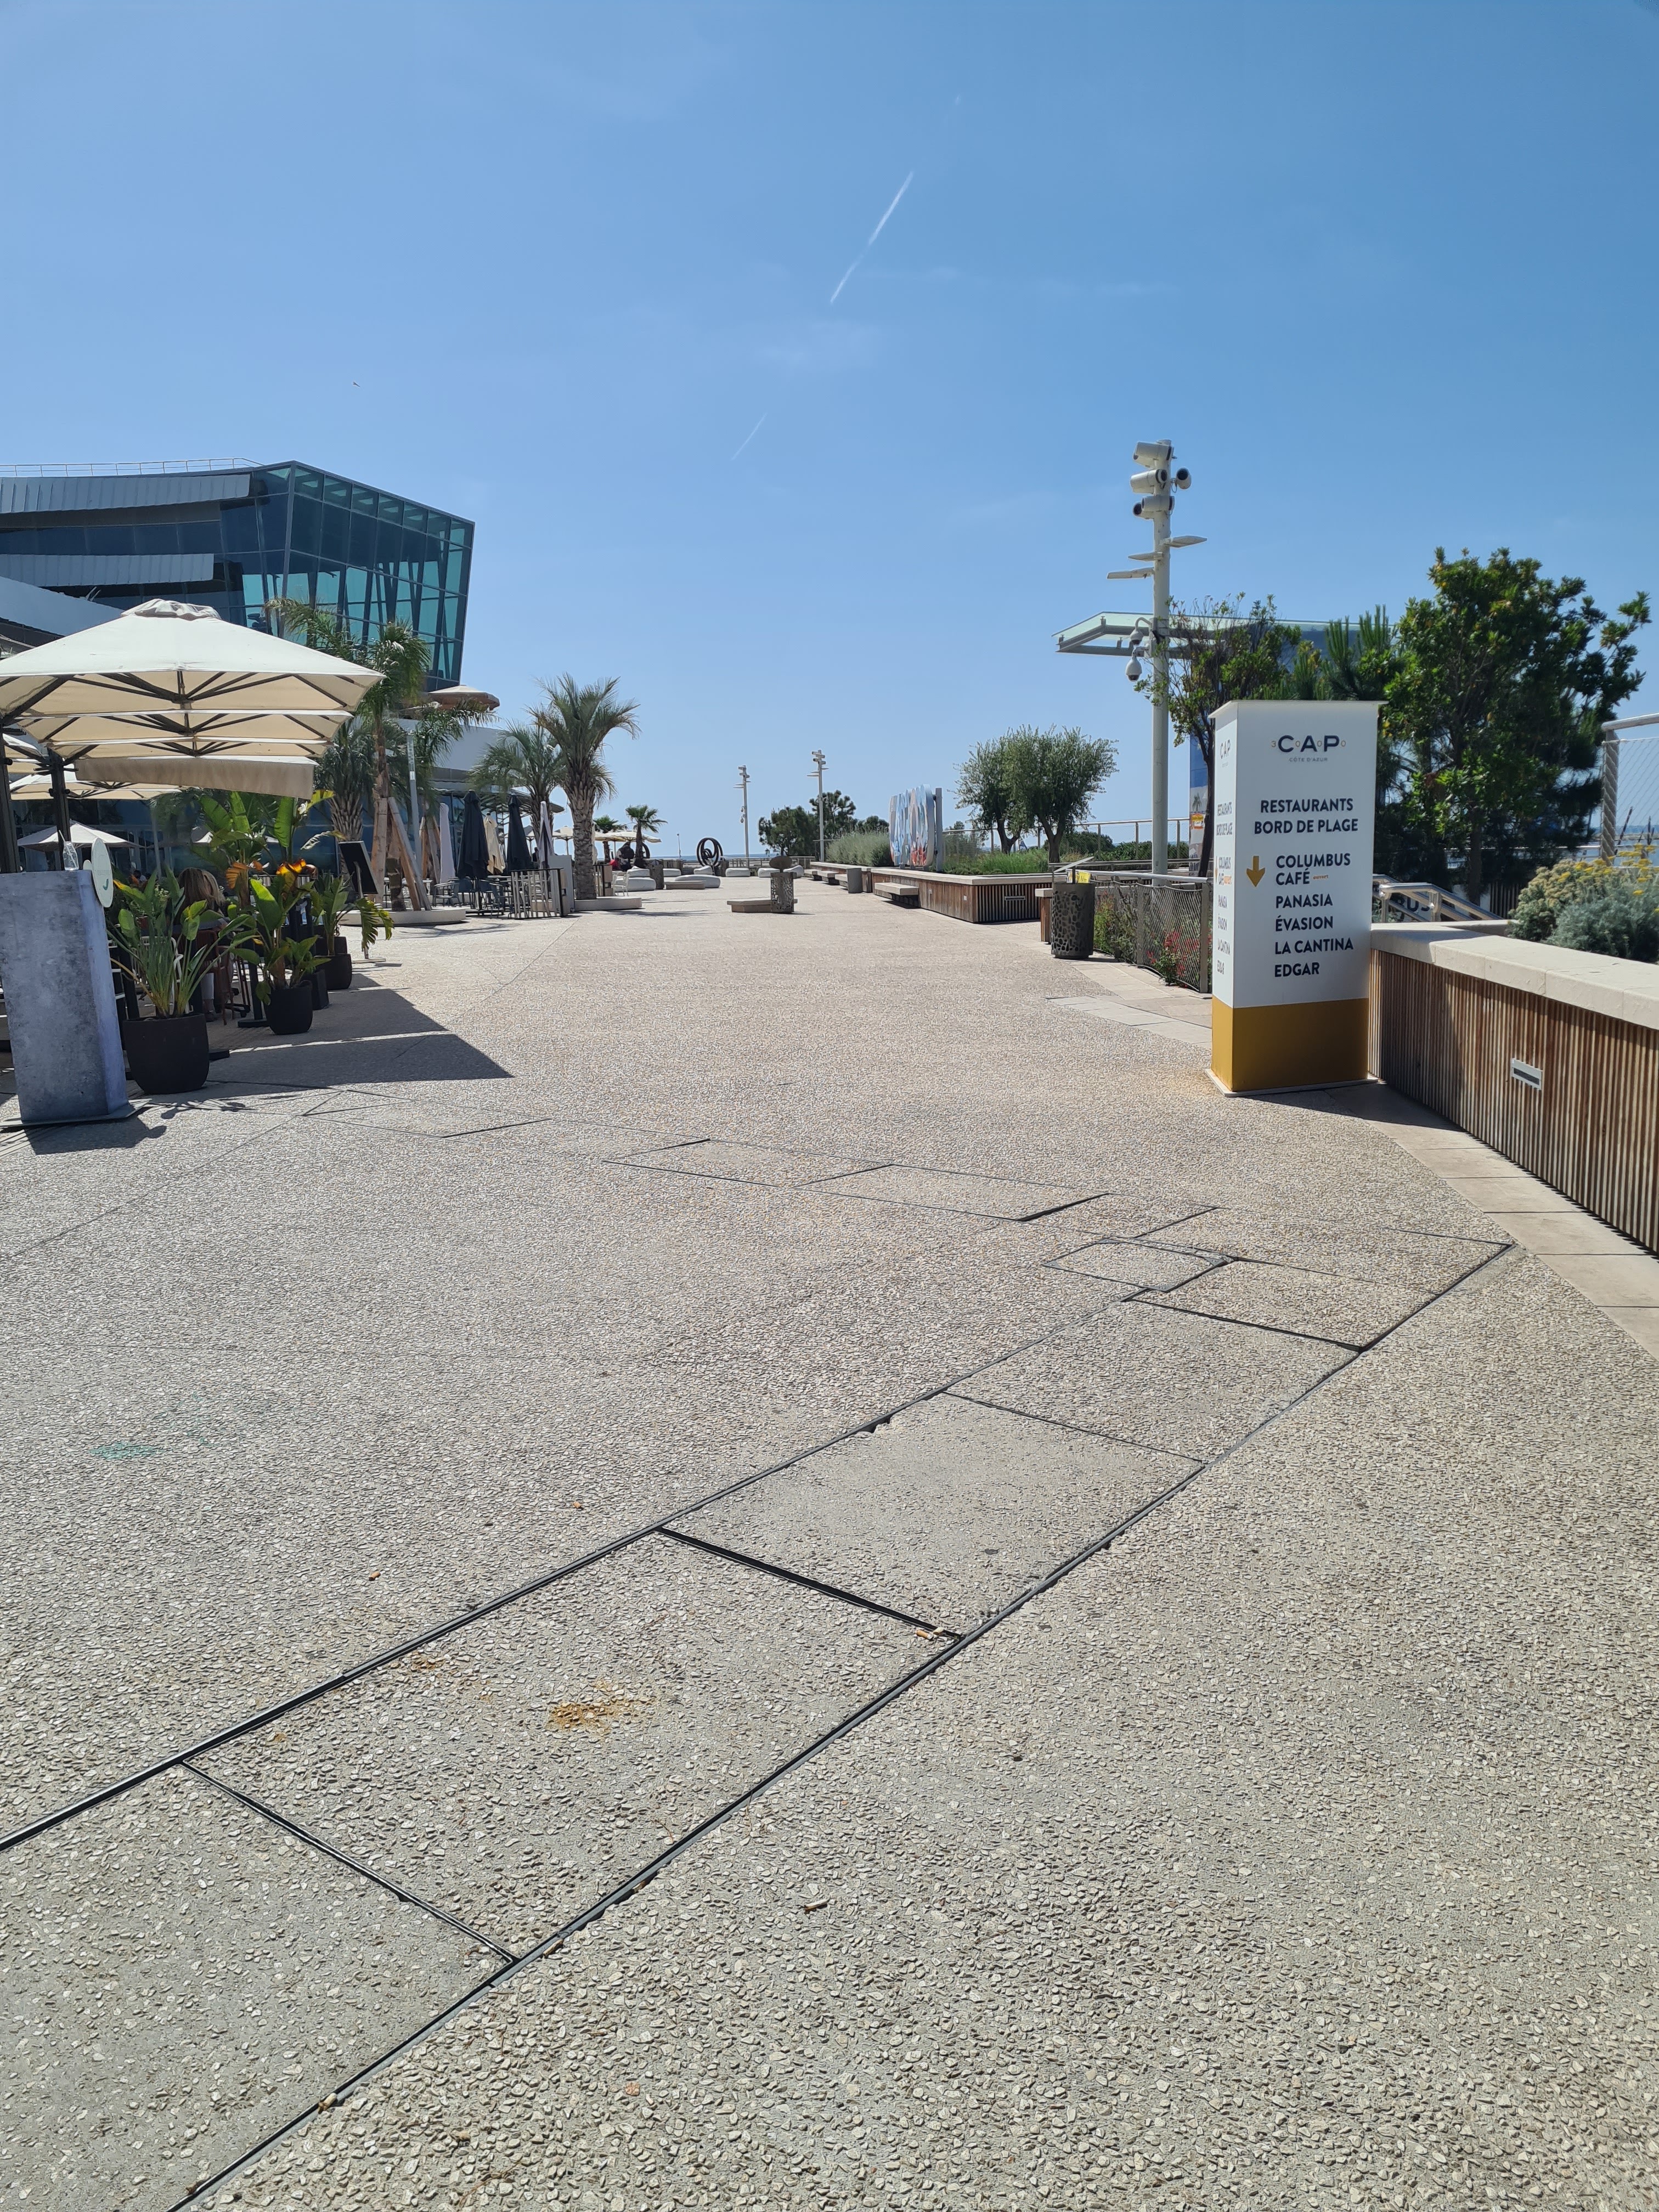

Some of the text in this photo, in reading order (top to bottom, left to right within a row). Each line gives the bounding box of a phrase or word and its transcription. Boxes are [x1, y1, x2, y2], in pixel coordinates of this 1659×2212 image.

[1261, 798, 1353, 813] RESTAURANTS
[1254, 818, 1358, 834] BORD DE PLAGE
[1276, 853, 1351, 868] COLUMBUS
[1276, 868, 1310, 885] CAFÉ
[1276, 893, 1333, 909] PANASIA
[1276, 915, 1333, 932] ÉVASION
[1275, 937, 1354, 955] LA CANTINA
[1274, 962, 1320, 978] EDGAR
